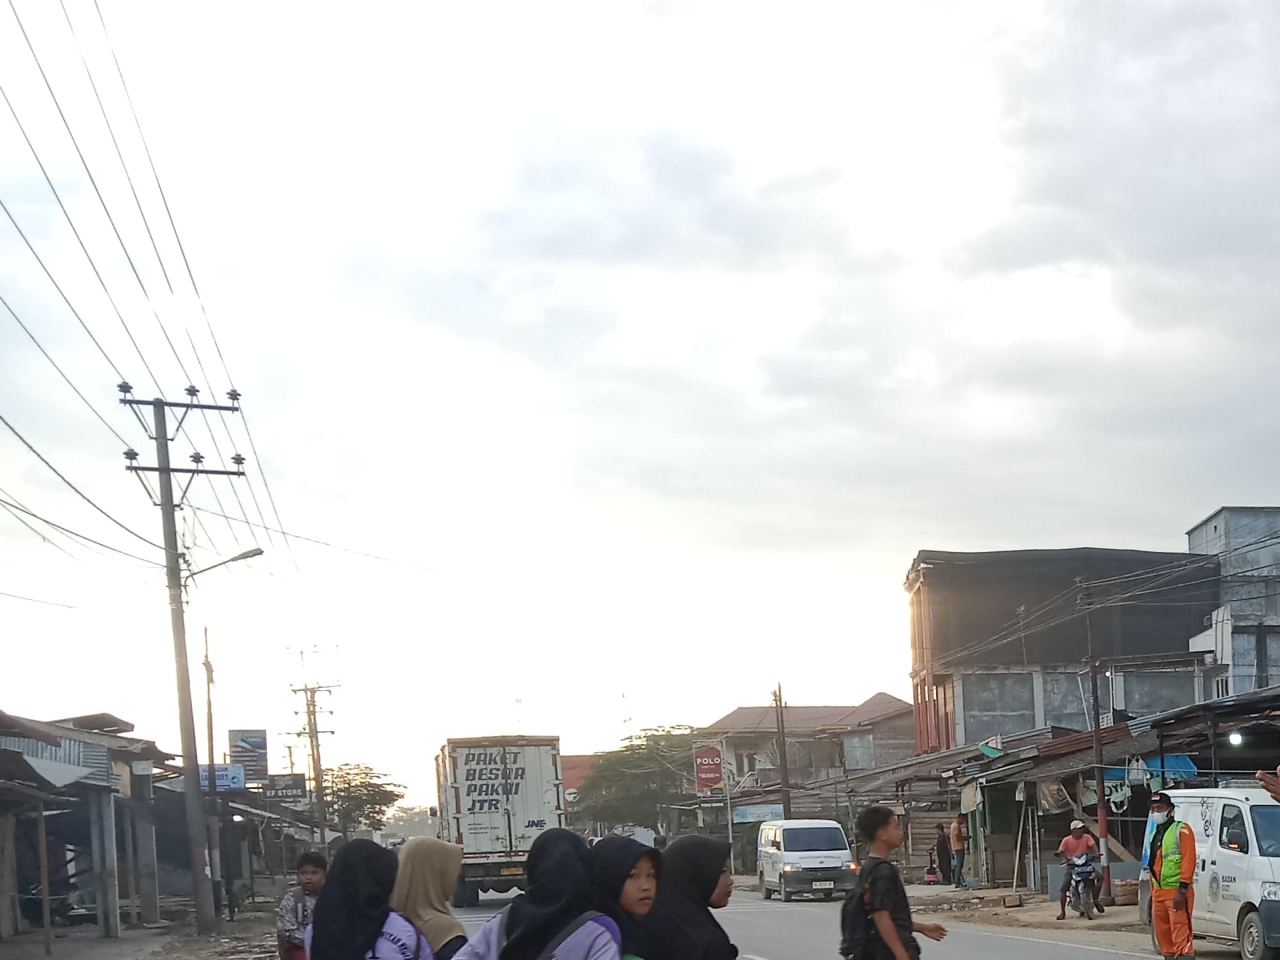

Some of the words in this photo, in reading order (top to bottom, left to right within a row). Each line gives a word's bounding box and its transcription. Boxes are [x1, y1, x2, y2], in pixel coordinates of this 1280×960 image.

[464, 752, 521, 765] PAKET
[697, 757, 720, 765] POLO
[465, 767, 526, 781] BESAR
[277, 789, 302, 797] STORE
[467, 799, 500, 811] JTR
[525, 820, 546, 828] JNE
[1222, 875, 1236, 883] BADAN
